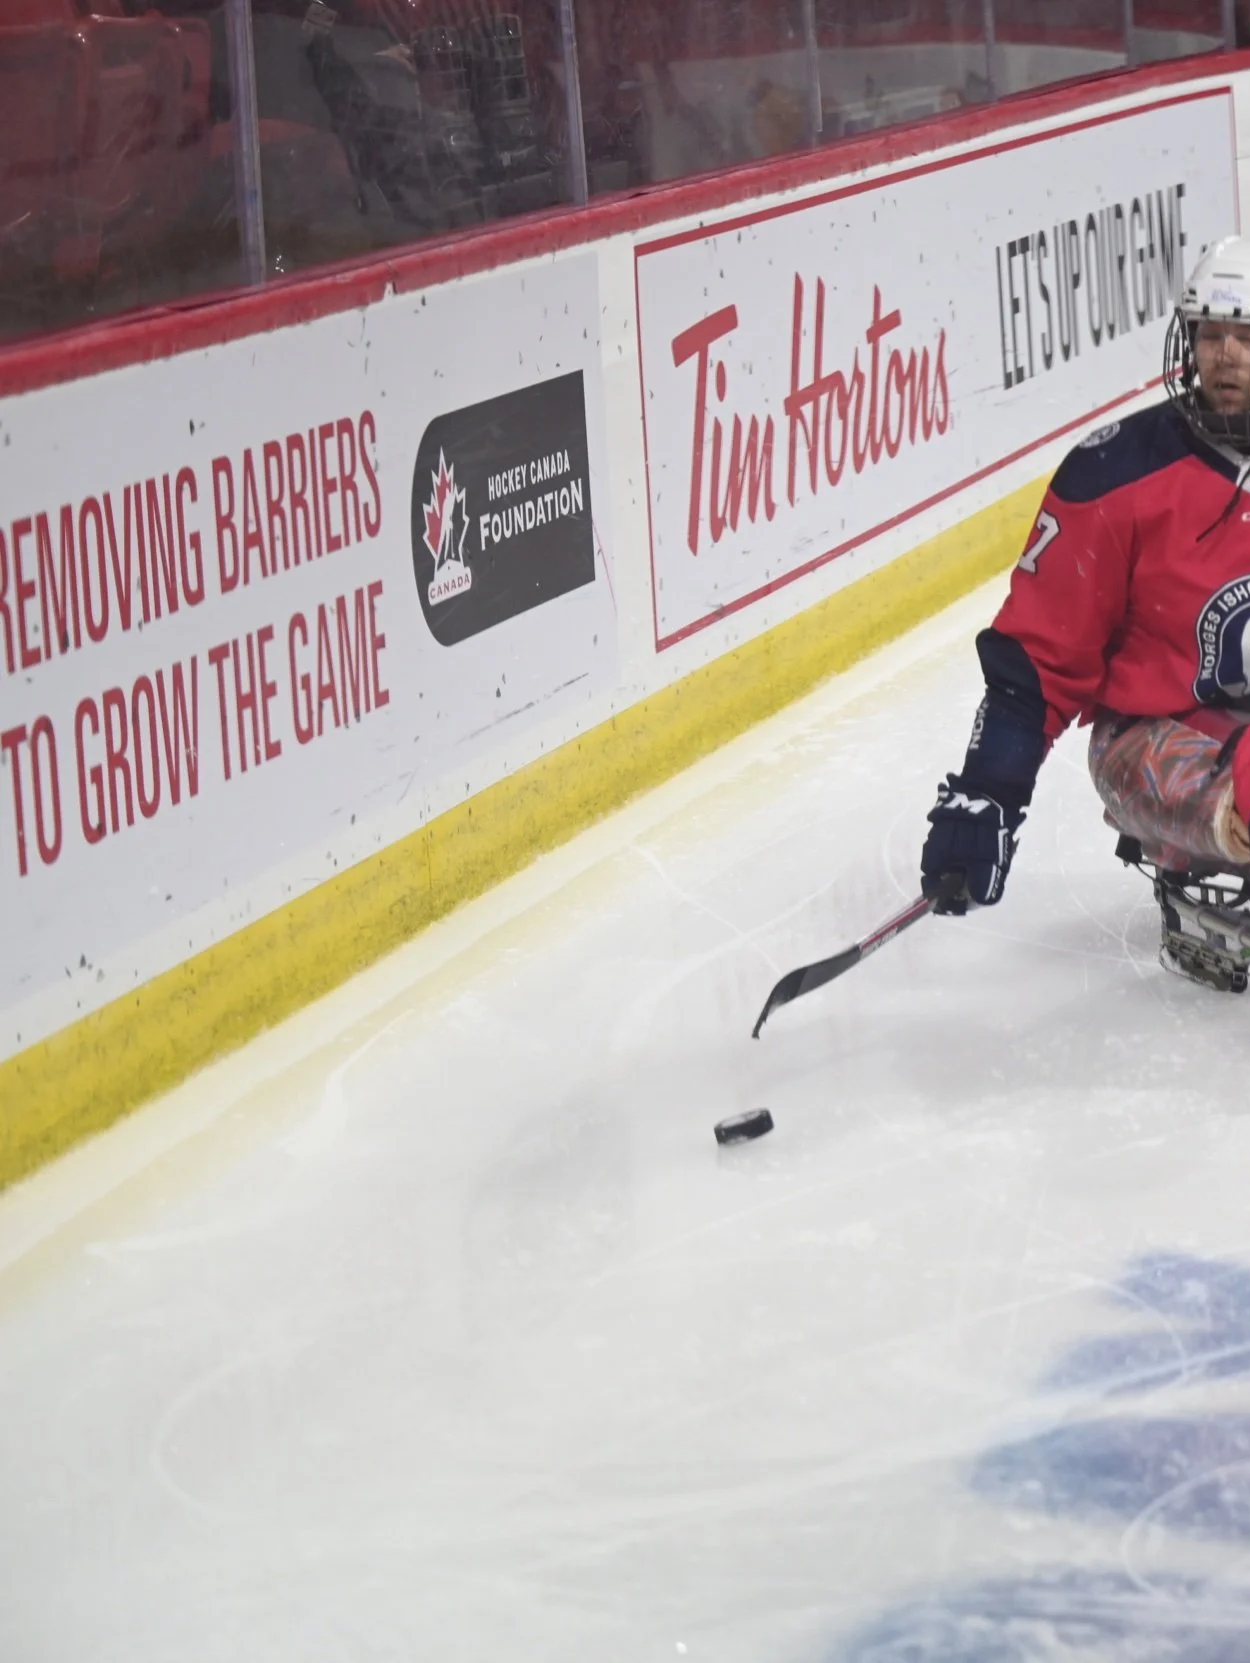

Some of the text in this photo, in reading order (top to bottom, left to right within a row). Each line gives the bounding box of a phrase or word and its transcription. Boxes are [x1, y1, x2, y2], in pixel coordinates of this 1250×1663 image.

[996, 183, 1187, 390] LET'S UP OUR GAME
[488, 449, 571, 501] HOCKEY CANADA
[671, 272, 949, 556] Tim Hortons
[211, 410, 382, 595] BARRIERS
[479, 478, 584, 551] FOUNDATION
[1018, 509, 1061, 575] 7
[430, 573, 470, 599] CANADA
[1, 580, 390, 878] TO GROW THE GAME
